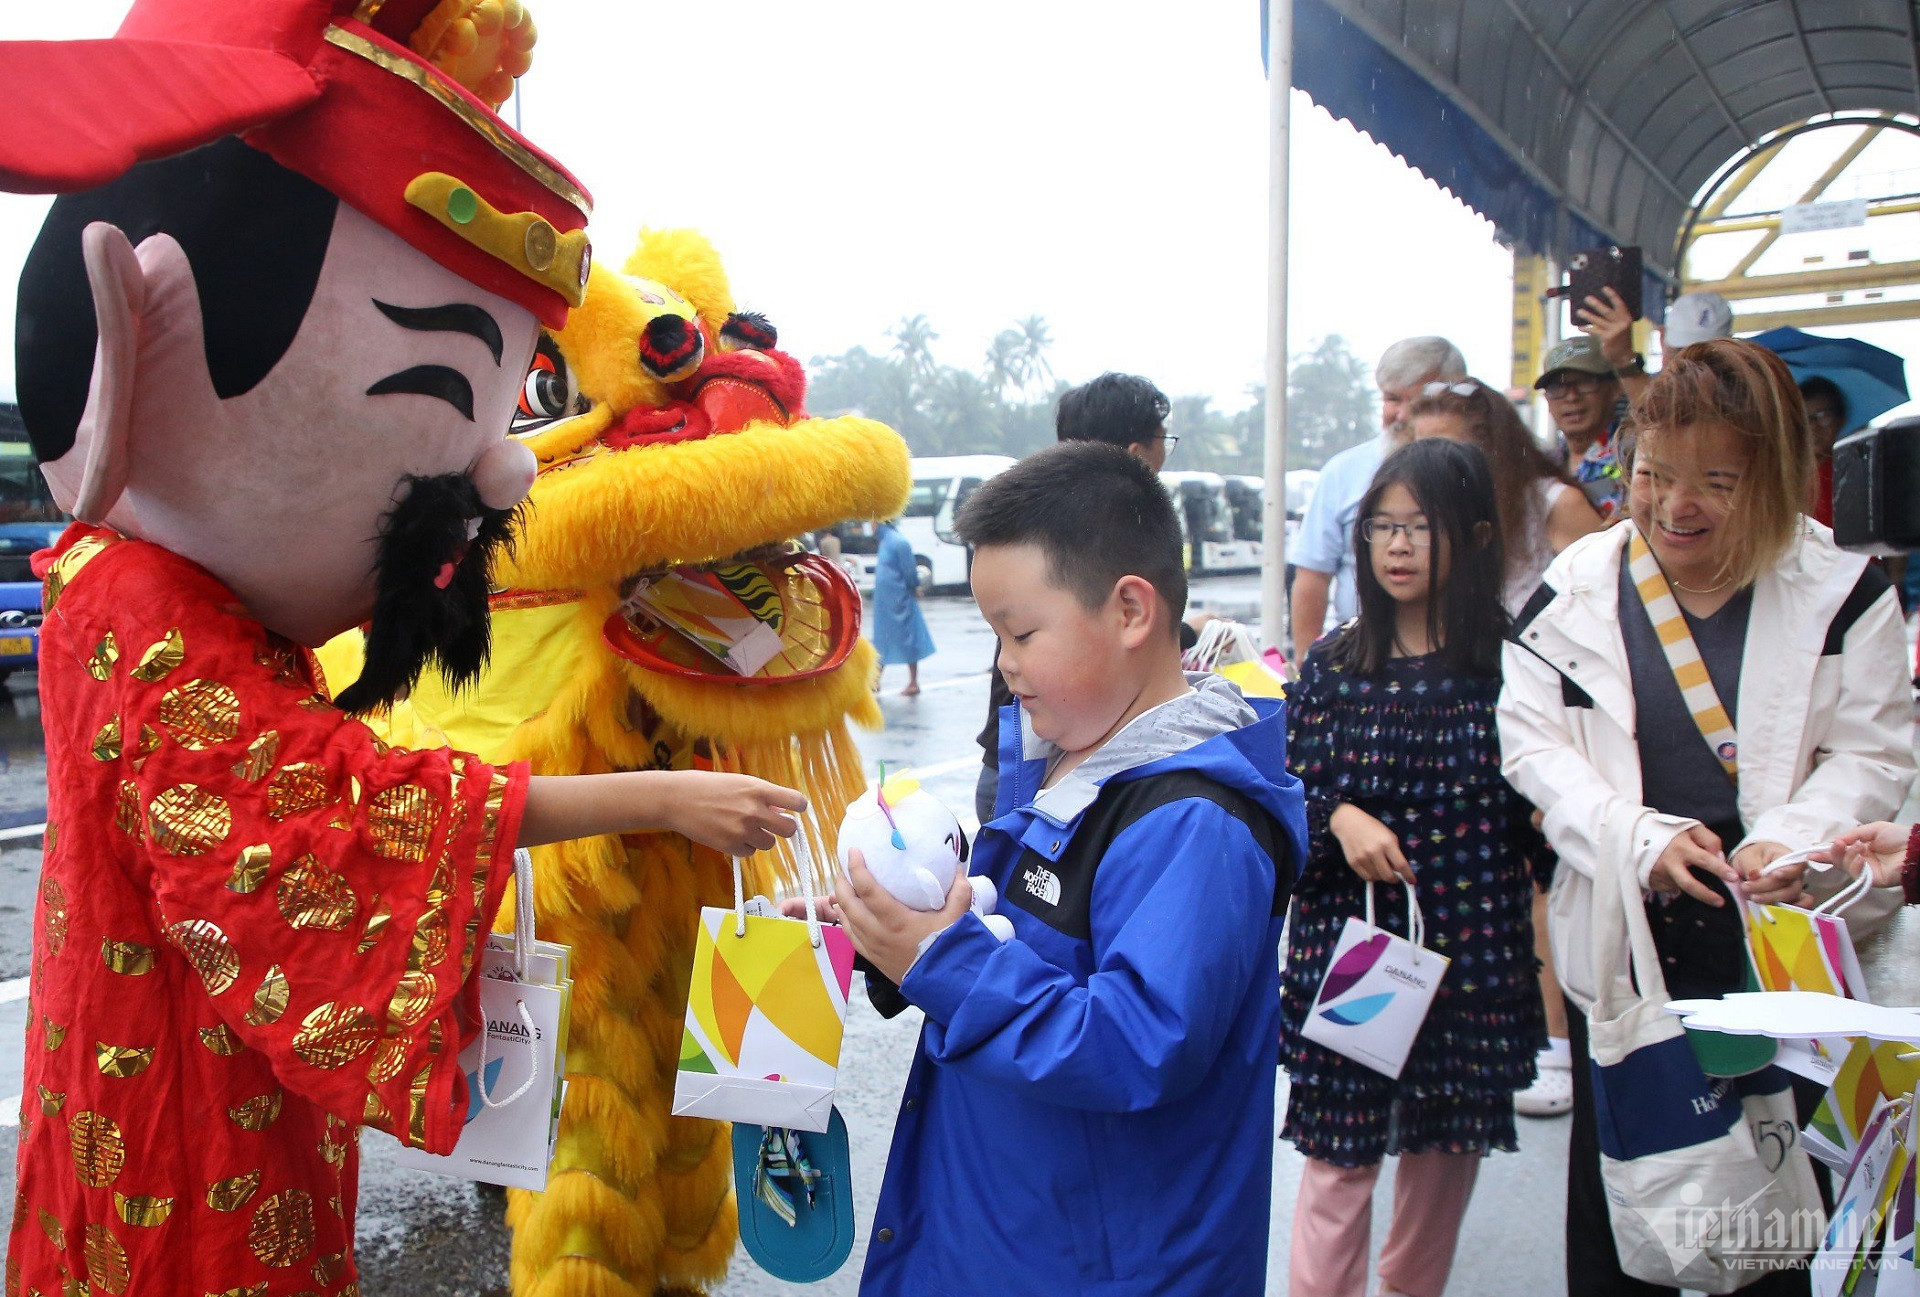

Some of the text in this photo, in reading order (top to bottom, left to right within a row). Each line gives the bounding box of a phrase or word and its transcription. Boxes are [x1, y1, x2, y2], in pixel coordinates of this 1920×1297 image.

[1022, 869, 1048, 891] NORTH
[1037, 864, 1051, 881] THE
[1025, 881, 1047, 899] FACE
